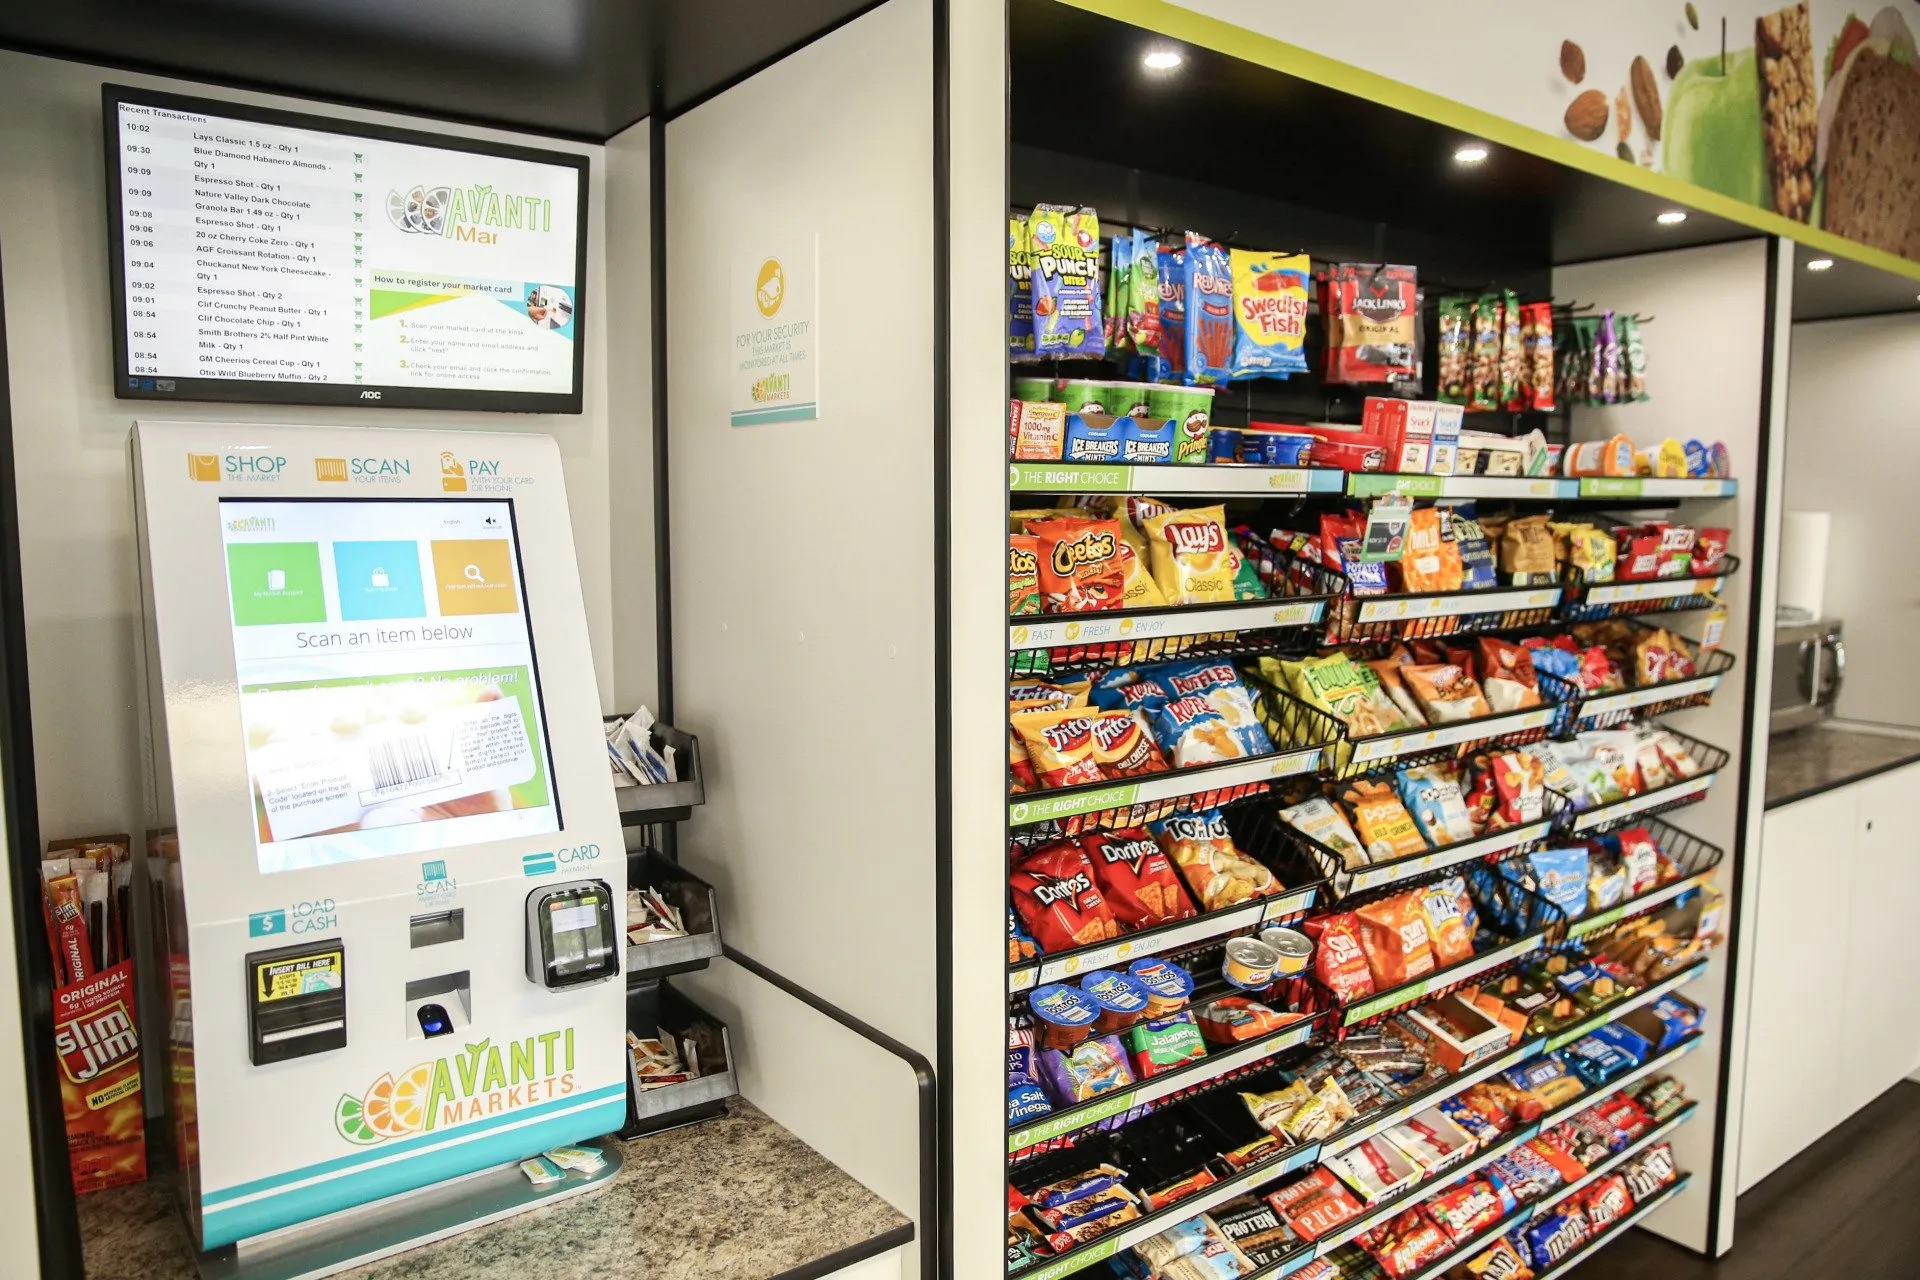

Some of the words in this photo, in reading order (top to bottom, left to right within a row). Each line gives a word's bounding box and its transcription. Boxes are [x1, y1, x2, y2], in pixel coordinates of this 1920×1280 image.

[120, 104, 149, 115] Recent
[152, 109, 207, 123] Transactions
[127, 123, 150, 132] 10:02
[127, 145, 150, 154] 09:30
[194, 133, 213, 142] Lays
[216, 136, 246, 146] Classic
[279, 144, 292, 152] Qty
[194, 147, 212, 156] Blue
[215, 150, 250, 160] Diamond
[254, 156, 290, 165] Habanero
[293, 160, 326, 170] Almonds
[446, 184, 550, 238] AVANTI
[456, 225, 498, 245] Mar
[1052, 244, 1085, 260] SOUR
[1040, 255, 1099, 281] PUNCH
[374, 275, 393, 284] How
[408, 279, 440, 288] register
[442, 281, 461, 290] your
[463, 282, 492, 291] market
[494, 285, 512, 293] card
[1063, 276, 1086, 286] BITES
[429, 324, 444, 332] your
[446, 324, 469, 332] market
[508, 328, 524, 336] kiosk
[1259, 314, 1300, 336] Fish
[736, 334, 750, 348] FOR
[752, 329, 772, 344] YOUR
[774, 321, 809, 340] SECURITY
[360, 390, 381, 399] AOC
[767, 391, 790, 401] MARKETS
[1024, 432, 1051, 440] Vitamin
[1052, 433, 1058, 441] C
[1073, 438, 1084, 451] ICE
[1086, 440, 1118, 453] BREAKERS
[1126, 440, 1137, 452] ICE
[1139, 442, 1169, 455] BREAKERS
[225, 456, 286, 473] SHOP
[1085, 453, 1105, 462] MINTS
[1137, 454, 1156, 462] MINTS
[351, 458, 410, 475] SCAN
[469, 460, 500, 475] PAY
[227, 474, 243, 482] THE
[246, 474, 281, 482] MARKET
[354, 475, 374, 483] YOUR
[376, 475, 401, 484] ITEMS
[1024, 472, 1042, 484] THE
[1045, 471, 1079, 484] RIGHT
[1081, 472, 1119, 484] CHOICE
[484, 484, 512, 492] PHONE
[1185, 578, 1223, 592] Classic
[296, 630, 342, 648] Scan
[349, 631, 370, 645] an
[376, 628, 416, 643] item
[422, 625, 472, 640] below
[1032, 629, 1055, 641] FAST
[1083, 625, 1110, 636] FRESH
[1136, 621, 1165, 632] ENJOY
[456, 671, 518, 688] problem!
[1170, 666, 1236, 696] RUFFLES
[1041, 717, 1093, 752] Frito
[1118, 759, 1131, 770] CHILI
[1131, 738, 1150, 765] CHEESE
[1032, 803, 1053, 815] THE
[1053, 798, 1087, 812] RIGHT
[1087, 790, 1124, 805] CHOICE
[558, 844, 600, 863] CARD
[1101, 840, 1159, 863] Doritos
[417, 878, 456, 895] SCAN
[1034, 872, 1091, 905] Doritos
[292, 898, 336, 918] LOAD
[292, 915, 338, 935] CASH
[270, 965, 294, 975] INSERT
[296, 963, 310, 971] BILL
[313, 958, 330, 966] HERE
[60, 971, 127, 1004] ORIGINAL
[85, 993, 102, 1003] GOOD
[102, 983, 125, 995] SOURCE
[96, 990, 120, 1004] PROTEIN
[70, 1002, 79, 1010] 6g
[1152, 1030, 1198, 1045] Jalapeño
[426, 1027, 575, 1130] AVANTI
[92, 1095, 104, 1106] NO
[443, 1074, 573, 1125] MARKETS
[1021, 1092, 1045, 1103] Salt
[1033, 1127, 1050, 1138] THE
[1053, 1112, 1085, 1131] RIGHT
[1086, 1098, 1123, 1118] CHOICE
[1221, 1211, 1279, 1242] PROTEIN
